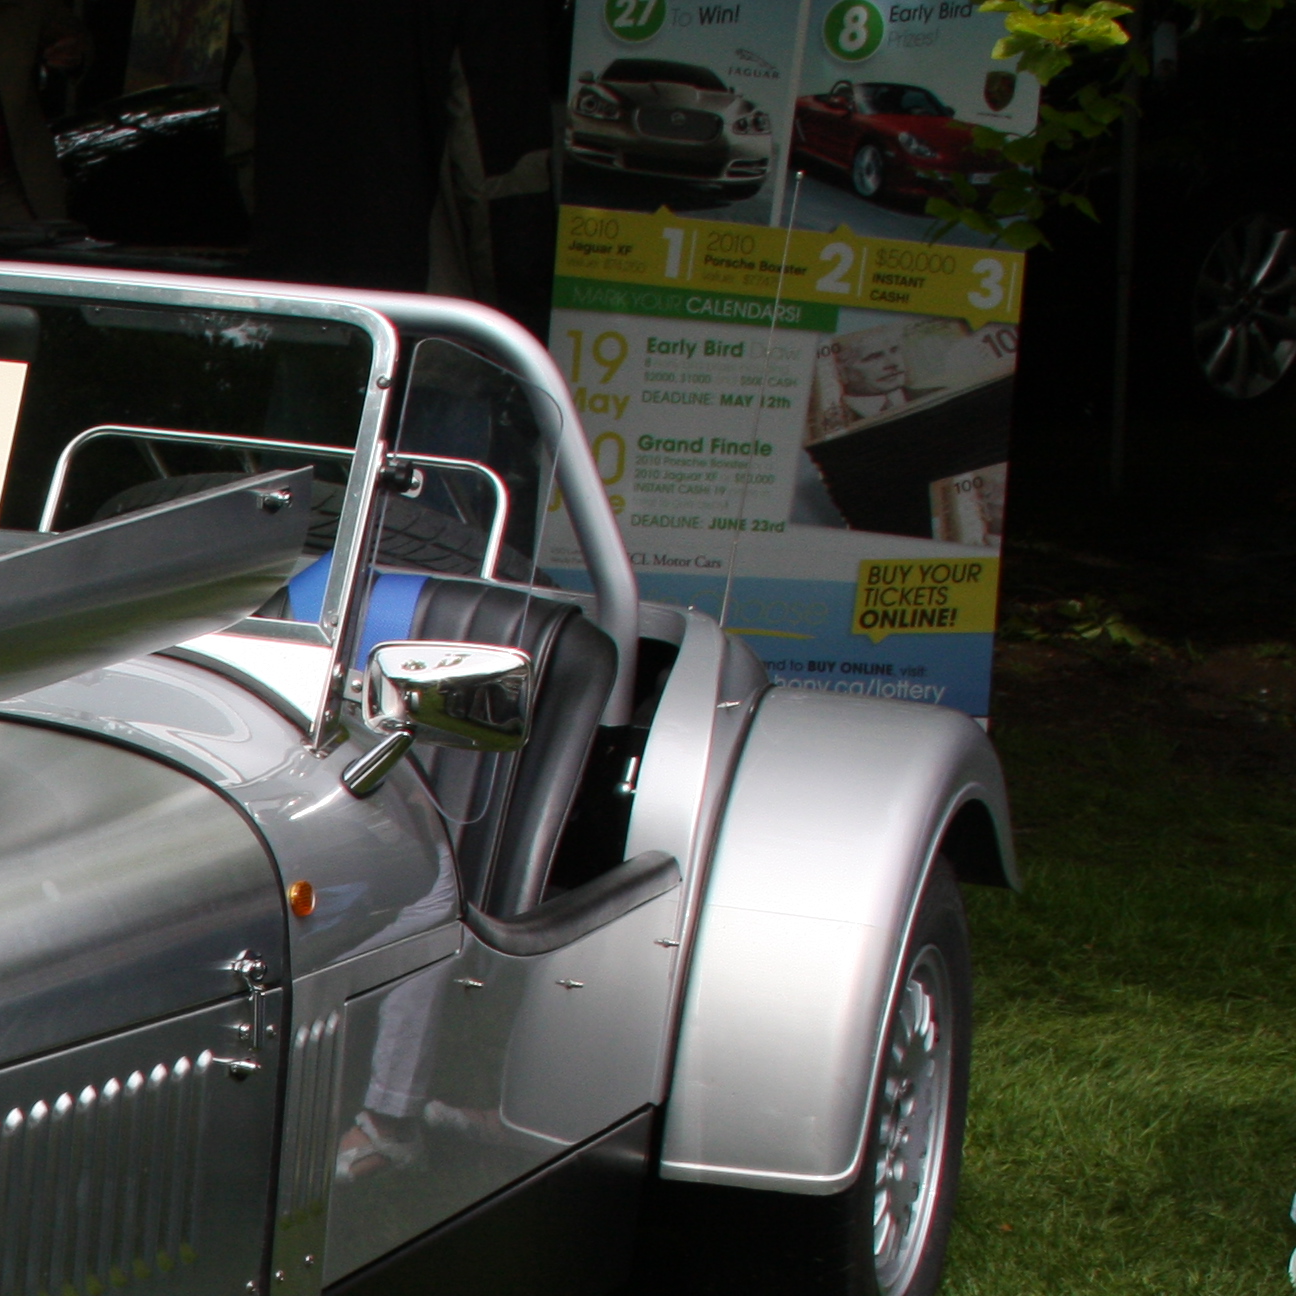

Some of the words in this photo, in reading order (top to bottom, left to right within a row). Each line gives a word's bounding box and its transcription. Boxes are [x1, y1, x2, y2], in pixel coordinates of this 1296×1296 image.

[698, 4, 740, 26] Win!
[838, 6, 871, 52] 8
[889, 3, 935, 24] Early
[938, 2, 973, 20] Bird
[728, 66, 781, 80] JAGUAR
[569, 215, 619, 239] 2010
[567, 240, 613, 257] Jaguar
[616, 244, 634, 256] XF
[662, 227, 685, 278] 1
[706, 231, 756, 256] 2010
[703, 253, 756, 271] Porsche
[815, 241, 856, 294] 2
[874, 247, 957, 275] $50,000
[871, 272, 927, 289] INSTANT
[967, 257, 1005, 311] 3
[685, 297, 803, 324] CALENDARS!
[566, 329, 630, 385] 19
[645, 336, 699, 360] Early
[703, 339, 746, 359] Bird
[641, 389, 713, 406] DEADLINE:
[718, 392, 755, 408] MAY
[758, 392, 792, 409] 12th
[636, 433, 704, 454] Grand
[708, 436, 773, 457] Finale
[592, 430, 627, 486] 0
[635, 454, 661, 467] 2010
[663, 455, 708, 468] Porsche
[634, 467, 660, 480] 2010
[662, 470, 703, 483] Jaguar
[953, 475, 984, 494] 100
[633, 482, 675, 495] INSTANT
[546, 487, 626, 516] Je
[630, 514, 704, 530] DEADLINE:
[707, 517, 748, 532] JUNE
[750, 518, 786, 534] 23rd
[627, 552, 649, 565] CL
[653, 553, 692, 567] Motor
[694, 554, 722, 569] Cars
[866, 564, 910, 587] BUY
[915, 562, 984, 584] YOUR
[863, 585, 950, 609] TICKETS
[857, 607, 959, 630] ONLINE!
[764, 660, 786, 671] nd
[807, 660, 837, 673] BUY
